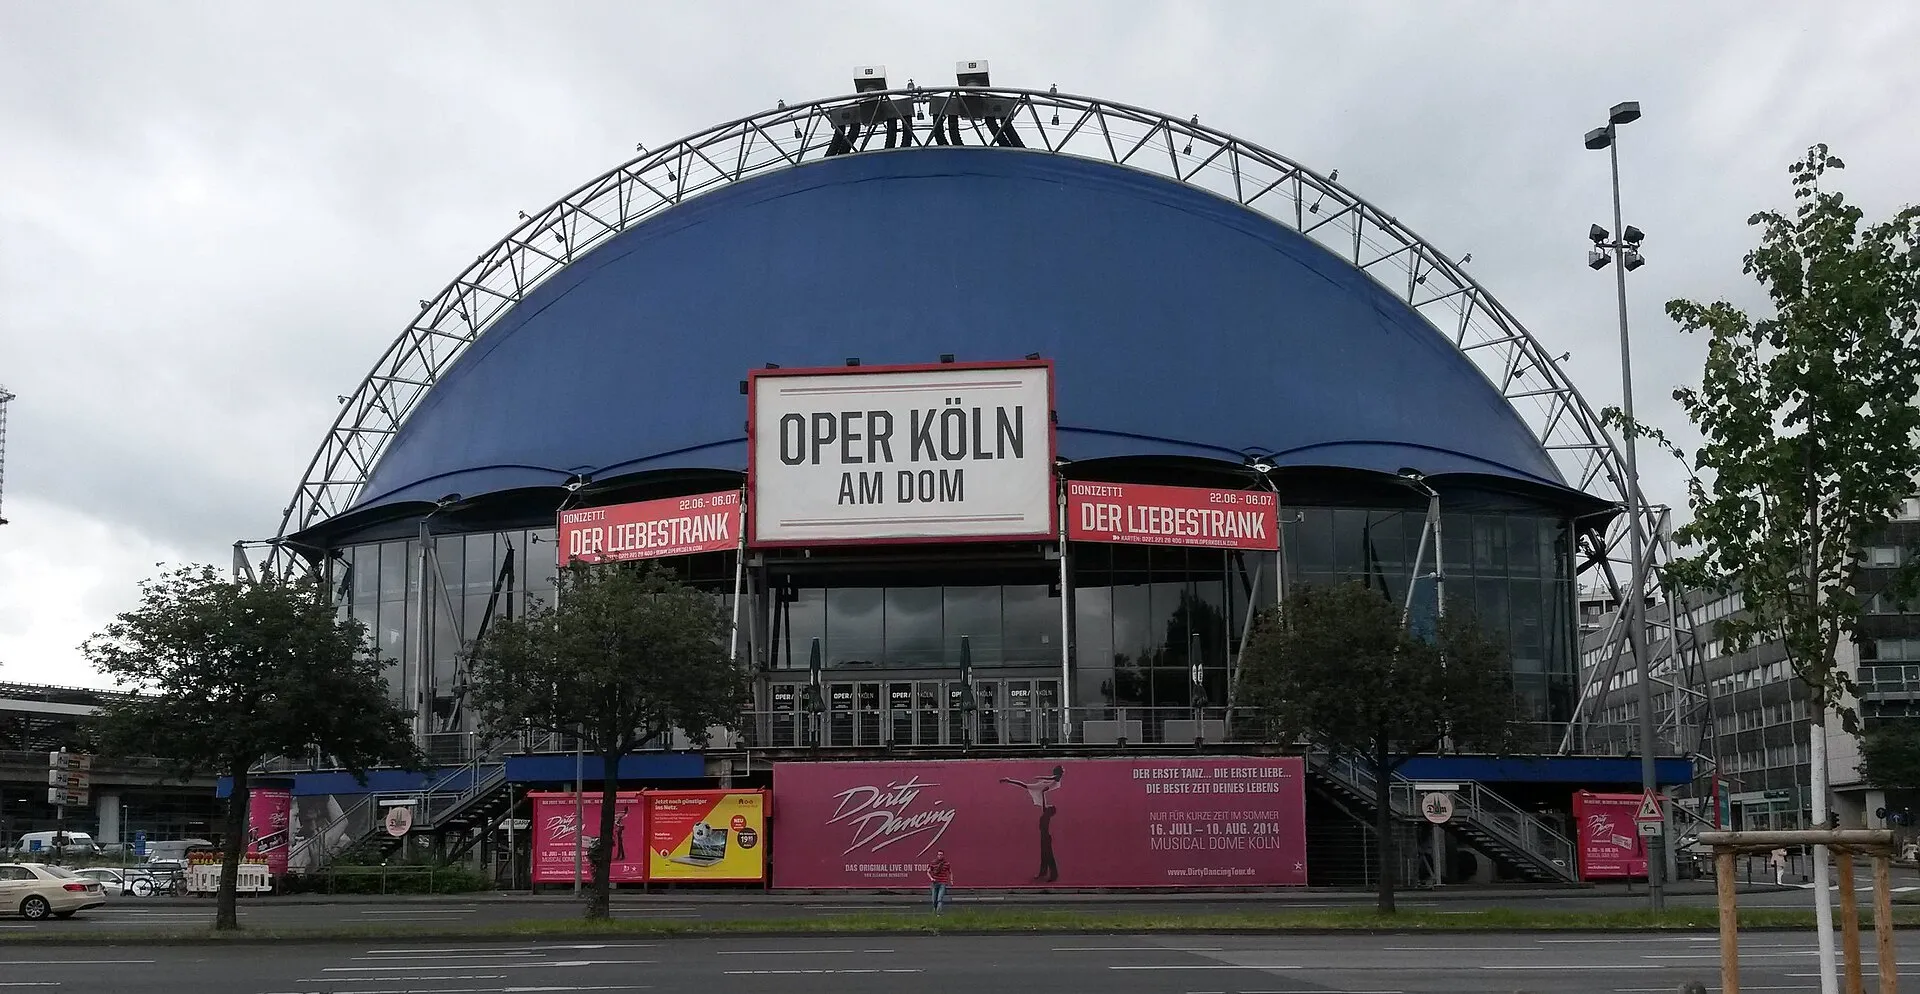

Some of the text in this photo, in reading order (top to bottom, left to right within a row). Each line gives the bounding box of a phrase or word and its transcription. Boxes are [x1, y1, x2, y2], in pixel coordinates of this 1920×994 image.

[780, 397, 1024, 466] OPER KÖLN
[838, 469, 964, 505] AM DOM
[1071, 484, 1123, 498] DONIZETTI
[712, 494, 738, 506] 06.07.
[1246, 495, 1274, 505] 06.07.
[564, 510, 605, 524] DONIZETTI
[1081, 502, 1266, 539] DER LIEBESTRANK
[570, 512, 729, 557] DER LIEBESTRANK
[1133, 768, 1291, 779] DER ERSTE TANZ... DIE ERSTE LIEBE...
[1146, 782, 1279, 794] DIE BESTE ZEIT DEINES LEBENS
[825, 776, 940, 825] Dirty
[1150, 810, 1279, 821] NUR FÜR KURZE ZEIT IM SOMMER
[841, 800, 955, 857] Dancing
[1150, 824, 1166, 835] 16.
[1169, 823, 1192, 835] JULI
[1207, 823, 1222, 834] 10.
[1226, 823, 1250, 834] AUG.
[1253, 823, 1279, 834] 2014
[1151, 833, 1280, 850] MUSICAL DOME KÖLN
[846, 864, 858, 872] DAS
[1168, 867, 1255, 877] www.DirtyDancingTour.de
